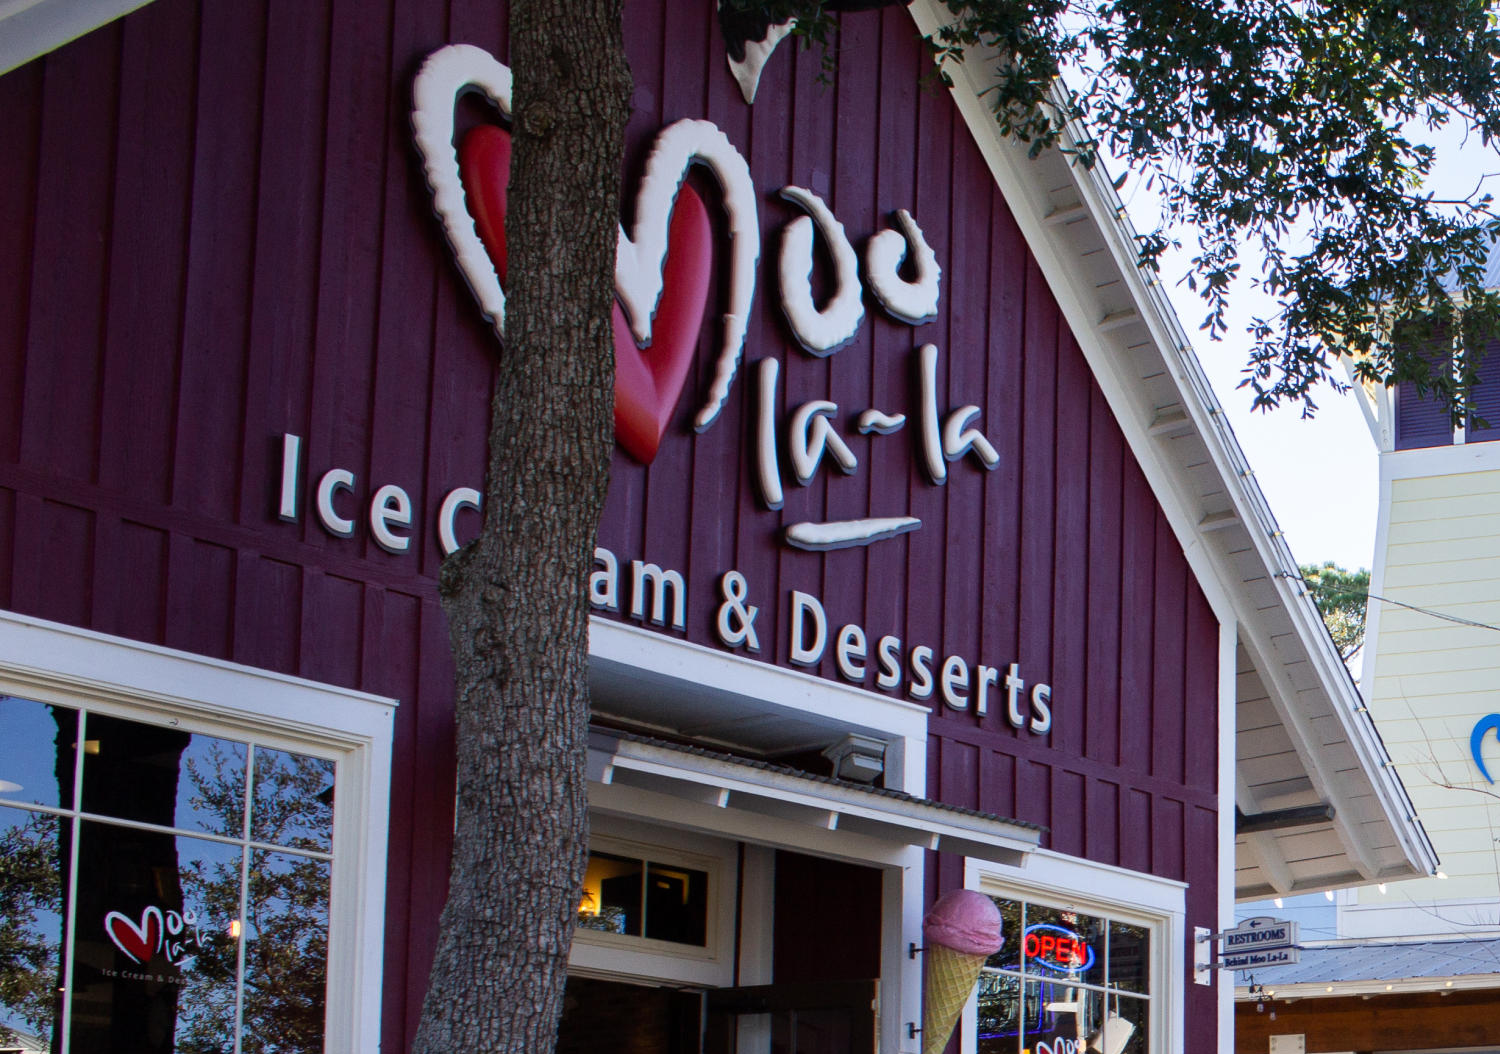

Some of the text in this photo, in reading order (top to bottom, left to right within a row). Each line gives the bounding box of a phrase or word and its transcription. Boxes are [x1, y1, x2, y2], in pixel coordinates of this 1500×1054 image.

[280, 433, 1054, 736] Ice Cam & Desserts
[1227, 928, 1286, 945] RESTROOMS
[1025, 933, 1087, 965] OPEN
[1225, 952, 1289, 968] Behind Moo La-La
[101, 967, 119, 977] Ice
[121, 969, 154, 981] Cream
